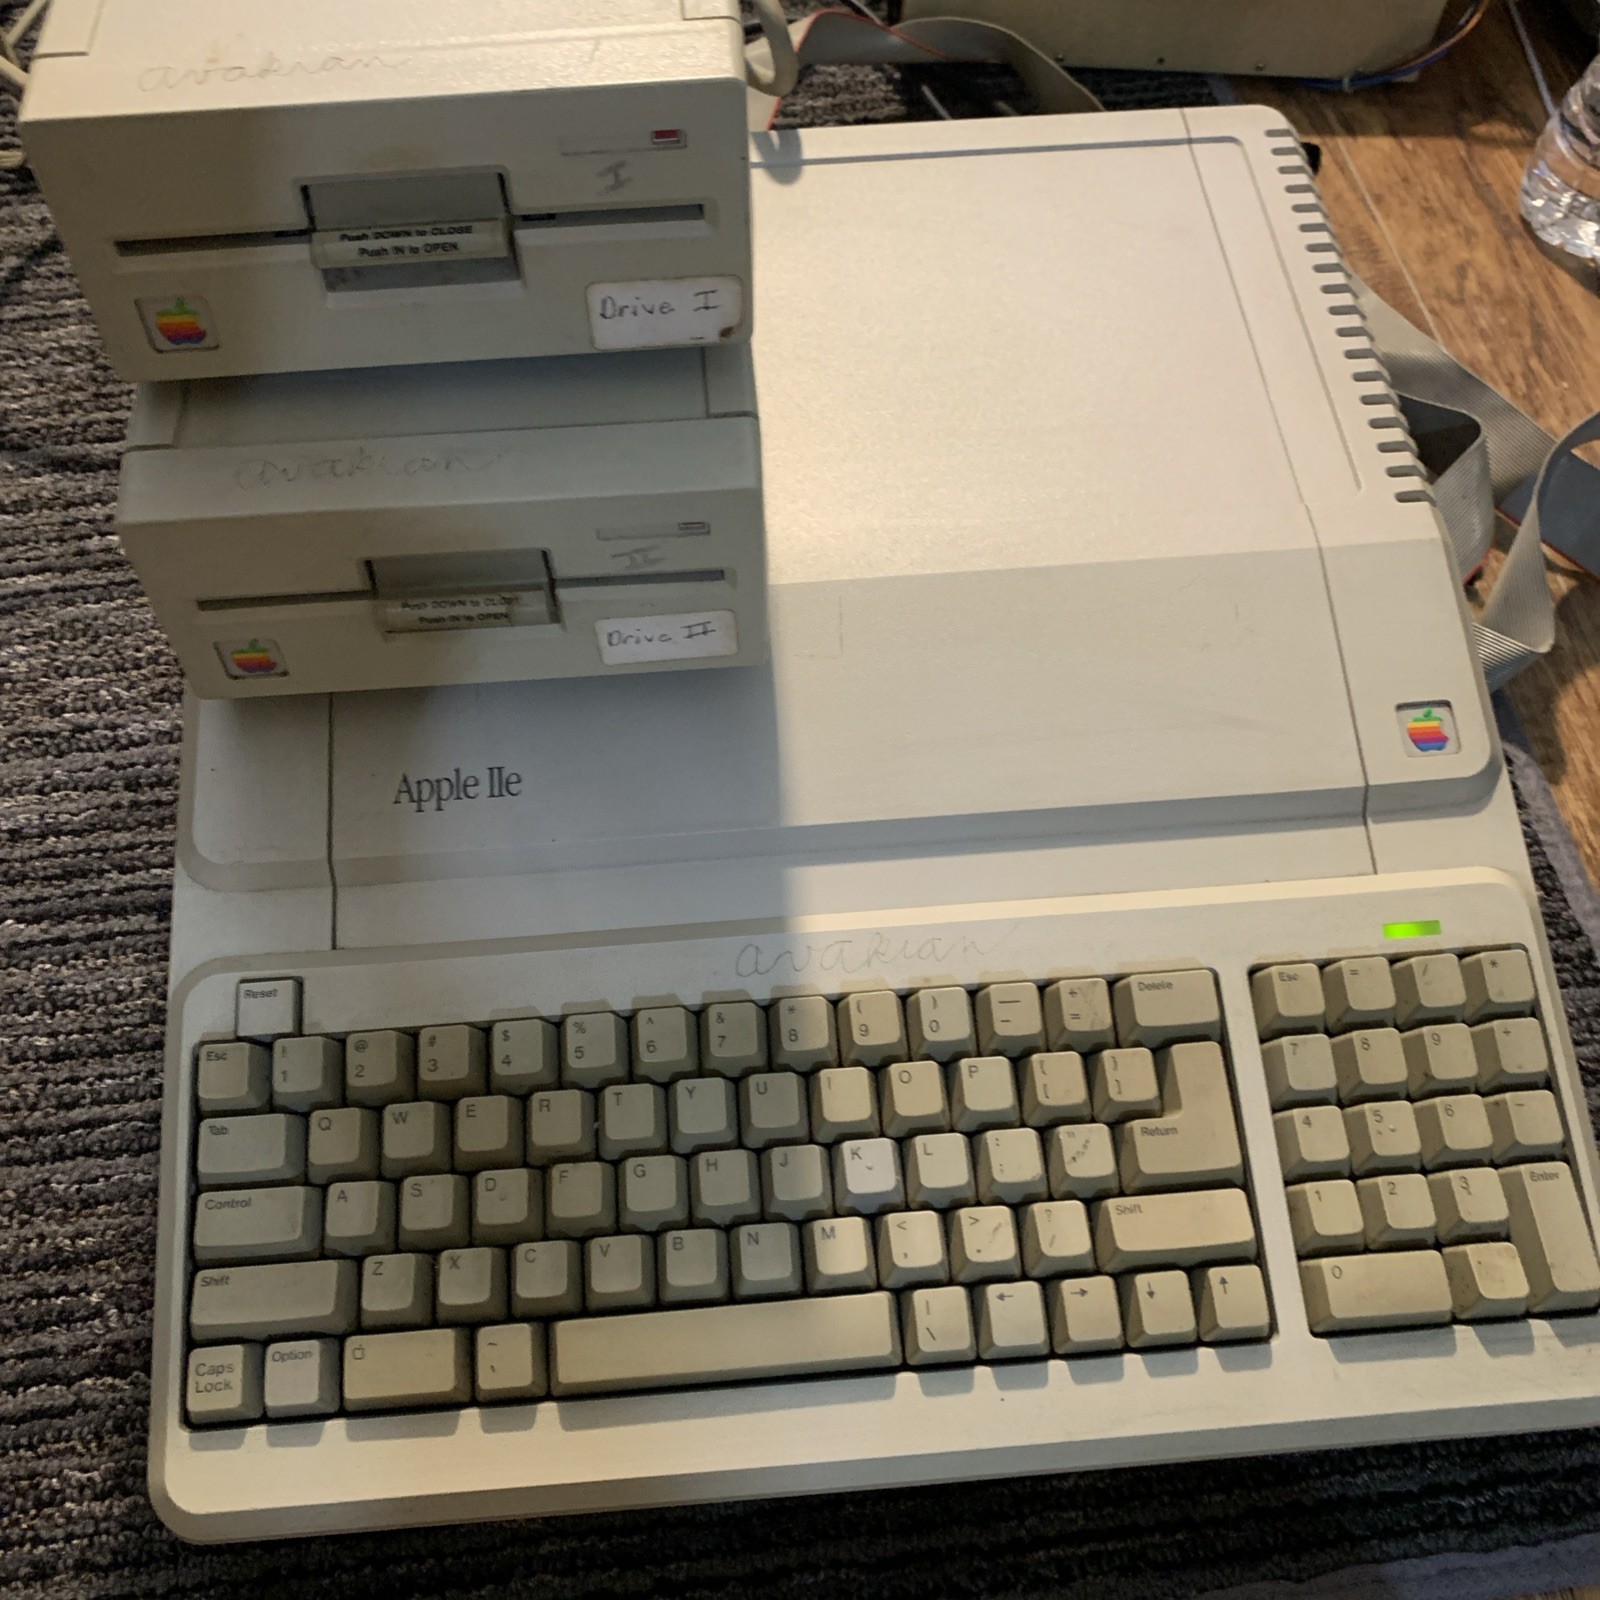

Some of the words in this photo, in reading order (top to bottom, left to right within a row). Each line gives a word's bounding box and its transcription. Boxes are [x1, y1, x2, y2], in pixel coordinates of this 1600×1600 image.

[340, 233, 369, 241] Push
[373, 230, 411, 240] DOWN
[415, 229, 428, 237] to
[431, 225, 473, 236] CLOSE
[358, 247, 388, 257] Push
[392, 245, 405, 255] IN
[409, 246, 420, 254] to
[424, 242, 458, 253] OPEN
[600, 296, 675, 319] Drive
[477, 612, 509, 621] OPEN
[607, 629, 672, 647] Drive
[681, 620, 716, 639] II
[393, 766, 479, 812] Apple
[1278, 971, 1299, 982] Esc
[1138, 980, 1173, 992] Delete
[244, 988, 278, 999] Reset
[716, 1012, 725, 1024] &
[574, 1021, 587, 1035] %
[859, 1024, 869, 1037] 9
[427, 1035, 437, 1047] #
[502, 1029, 510, 1043] $
[717, 1036, 727, 1048] 7
[789, 1030, 798, 1043] 8
[1360, 1036, 1370, 1050] 8
[1431, 1032, 1441, 1046] 9
[354, 1040, 369, 1053] @
[575, 1046, 584, 1060] 5
[646, 1040, 656, 1053] 6
[1290, 1042, 1298, 1056] 7
[206, 1051, 228, 1062] Esc
[502, 1054, 512, 1067] 4
[355, 1065, 365, 1078] 2
[427, 1059, 438, 1073] 3
[969, 1065, 978, 1078] P
[900, 1070, 912, 1084] O
[686, 1086, 696, 1099] Y
[757, 1081, 768, 1095] U
[539, 1099, 551, 1112] R
[613, 1093, 623, 1106] T
[466, 1104, 476, 1118] E
[1373, 1109, 1383, 1123] 5
[1445, 1103, 1455, 1117] 6
[318, 1117, 332, 1131] Q
[391, 1111, 409, 1125] W
[1302, 1114, 1312, 1127] 4
[208, 1125, 228, 1136] Tab
[1141, 1125, 1178, 1137] Return
[851, 1146, 863, 1160] K
[923, 1142, 933, 1156] L
[706, 1159, 718, 1172] H
[780, 1154, 788, 1167] J
[560, 1170, 568, 1183] F
[633, 1164, 646, 1179] G
[1530, 1171, 1560, 1183] Enter
[411, 1183, 422, 1197] S
[485, 1178, 496, 1191] D
[1388, 1181, 1397, 1195] 2
[1460, 1176, 1471, 1190] 3
[337, 1189, 348, 1203] A
[205, 1197, 251, 1210] Control
[1115, 1204, 1142, 1216] Shift
[747, 1232, 759, 1245] N
[821, 1226, 836, 1240] M
[673, 1236, 684, 1250] B
[524, 1249, 537, 1263] C
[599, 1244, 610, 1257] V
[372, 1262, 384, 1276] Z
[449, 1255, 461, 1270] X
[200, 1275, 230, 1287] Shift
[271, 1350, 313, 1363] Option
[195, 1361, 234, 1377] Caps
[195, 1379, 233, 1393] Lock
